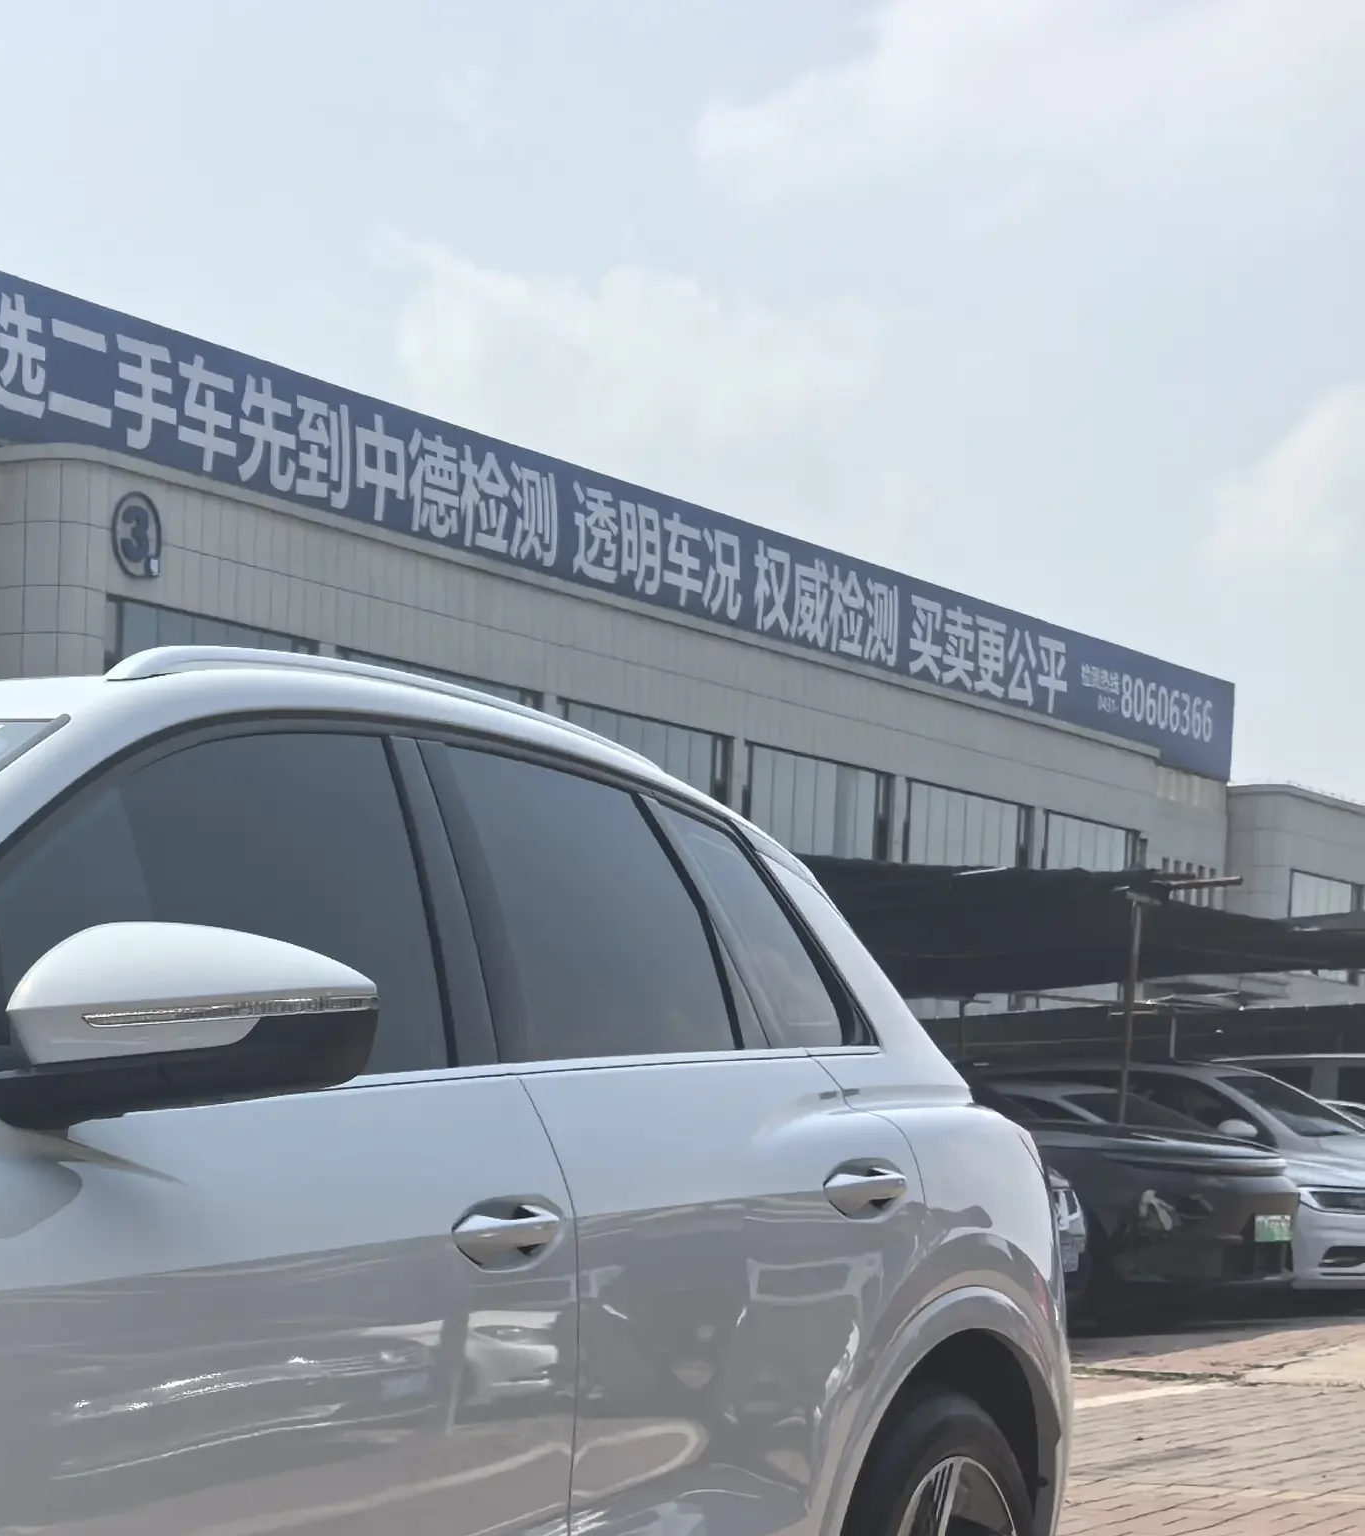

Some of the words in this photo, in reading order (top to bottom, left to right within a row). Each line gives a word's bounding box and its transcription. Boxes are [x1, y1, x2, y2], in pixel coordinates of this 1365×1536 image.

[572, 480, 741, 621] 透明车况
[753, 539, 899, 667] 权威检测
[910, 593, 1067, 713] 买卖更公平
[1120, 673, 1213, 742] 80606366
